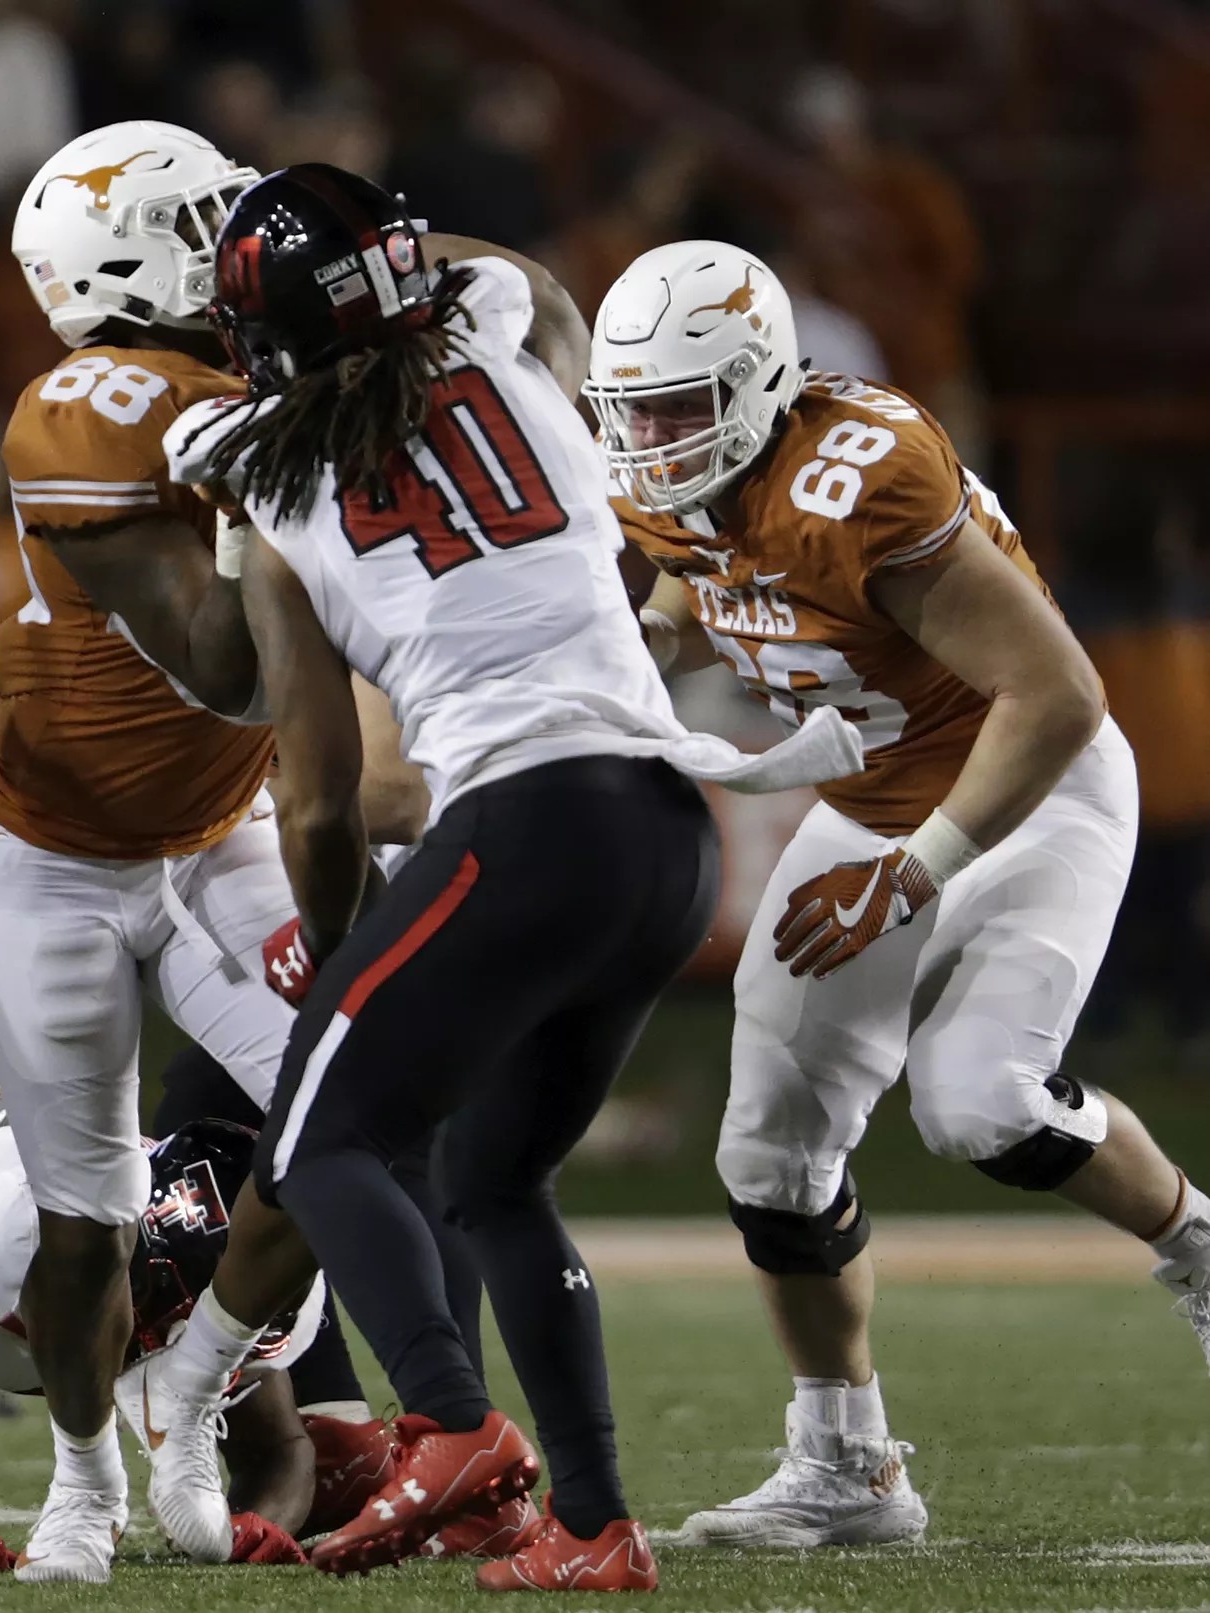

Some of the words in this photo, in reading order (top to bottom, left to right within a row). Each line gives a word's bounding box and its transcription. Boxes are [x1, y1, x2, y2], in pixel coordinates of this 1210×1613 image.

[39, 356, 169, 425] 88
[333, 363, 570, 580] 40
[790, 419, 896, 520] 68
[683, 571, 797, 635] TEXAS
